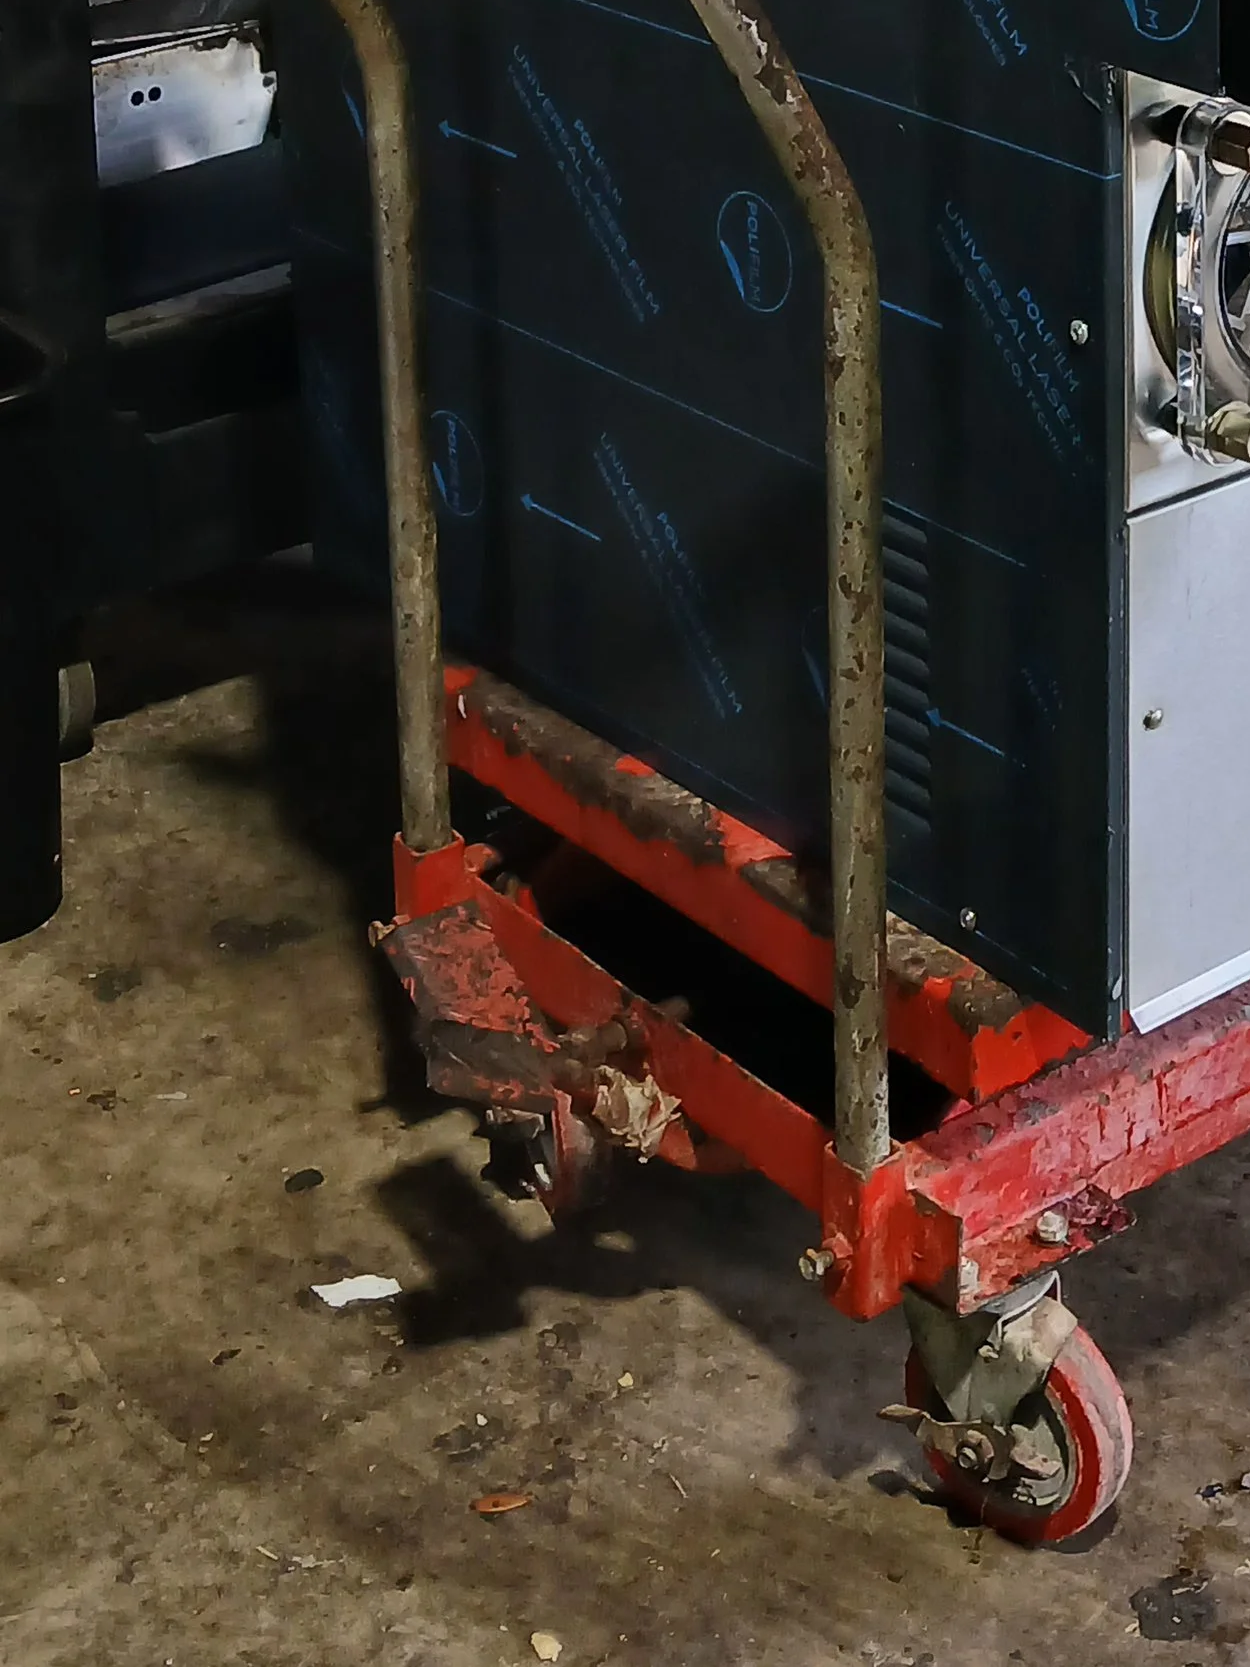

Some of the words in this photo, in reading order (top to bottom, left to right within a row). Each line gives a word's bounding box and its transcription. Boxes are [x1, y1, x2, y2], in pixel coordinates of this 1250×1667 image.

[745, 200, 761, 303] POLIFILM
[942, 200, 1030, 350] UNIVERSAL
[1017, 288, 1078, 391] POLIFILM
